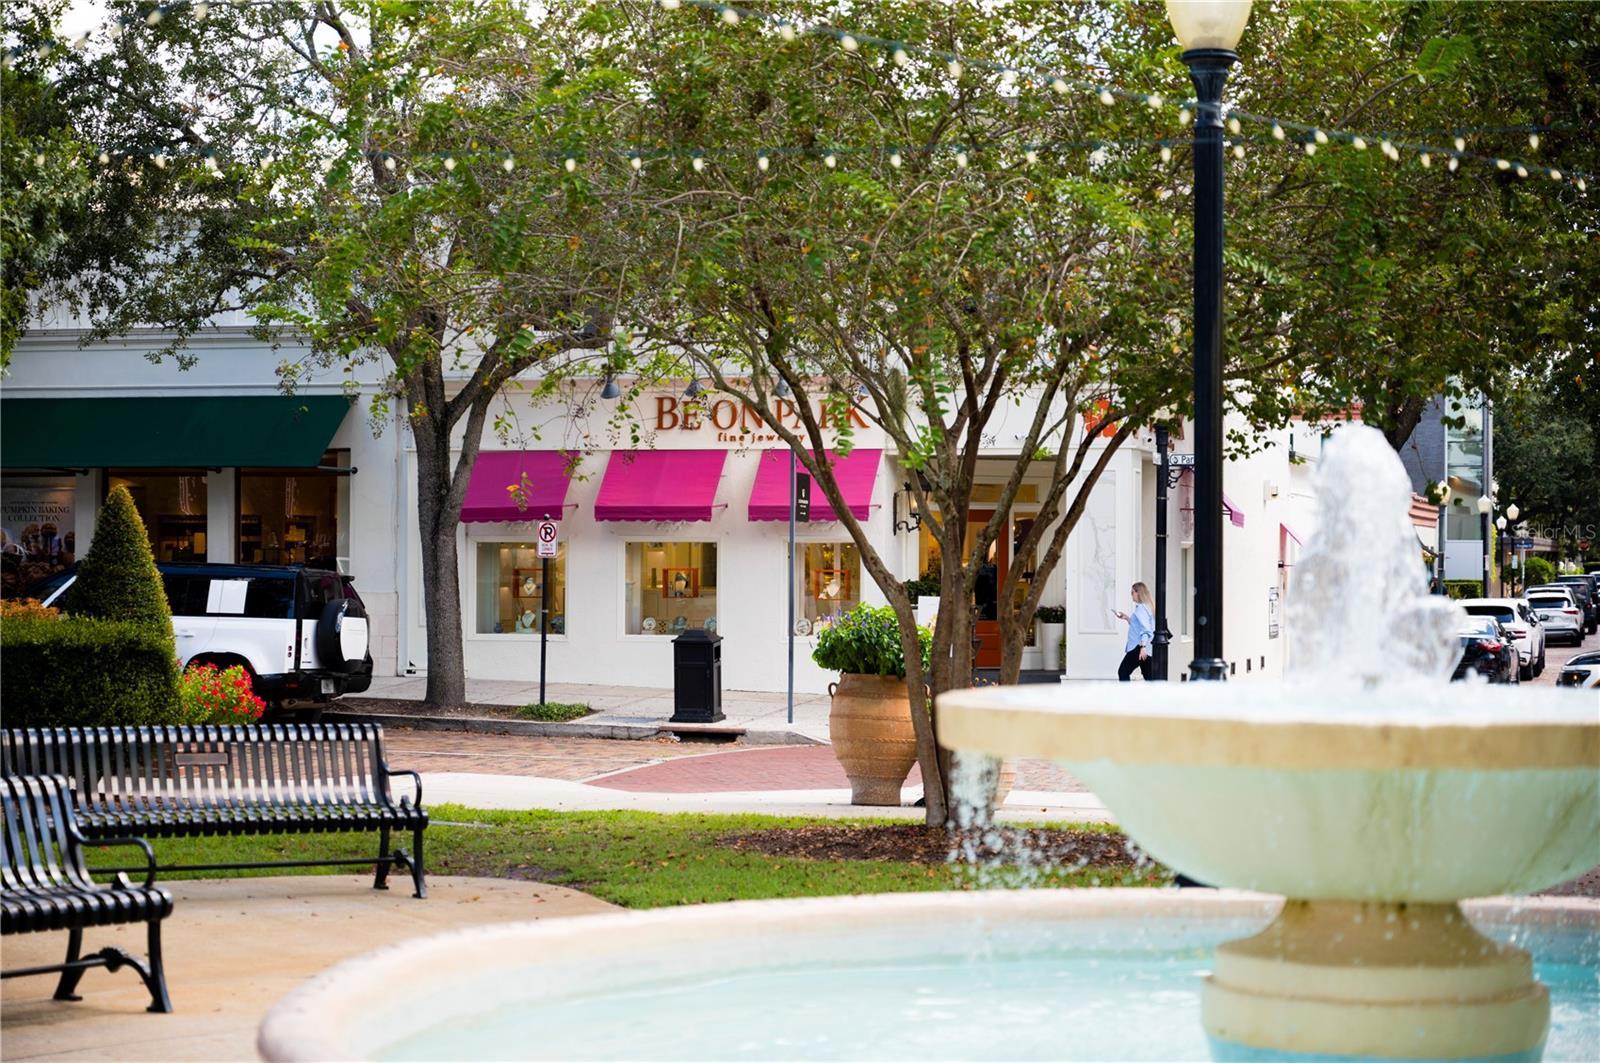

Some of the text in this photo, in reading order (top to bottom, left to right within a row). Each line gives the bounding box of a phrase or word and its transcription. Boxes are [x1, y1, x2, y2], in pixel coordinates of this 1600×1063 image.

[655, 396, 870, 431] BE ON PRK
[718, 432, 805, 444] fine jewey
[39, 505, 70, 513] BAKING
[8, 514, 61, 522] COLLECTION
